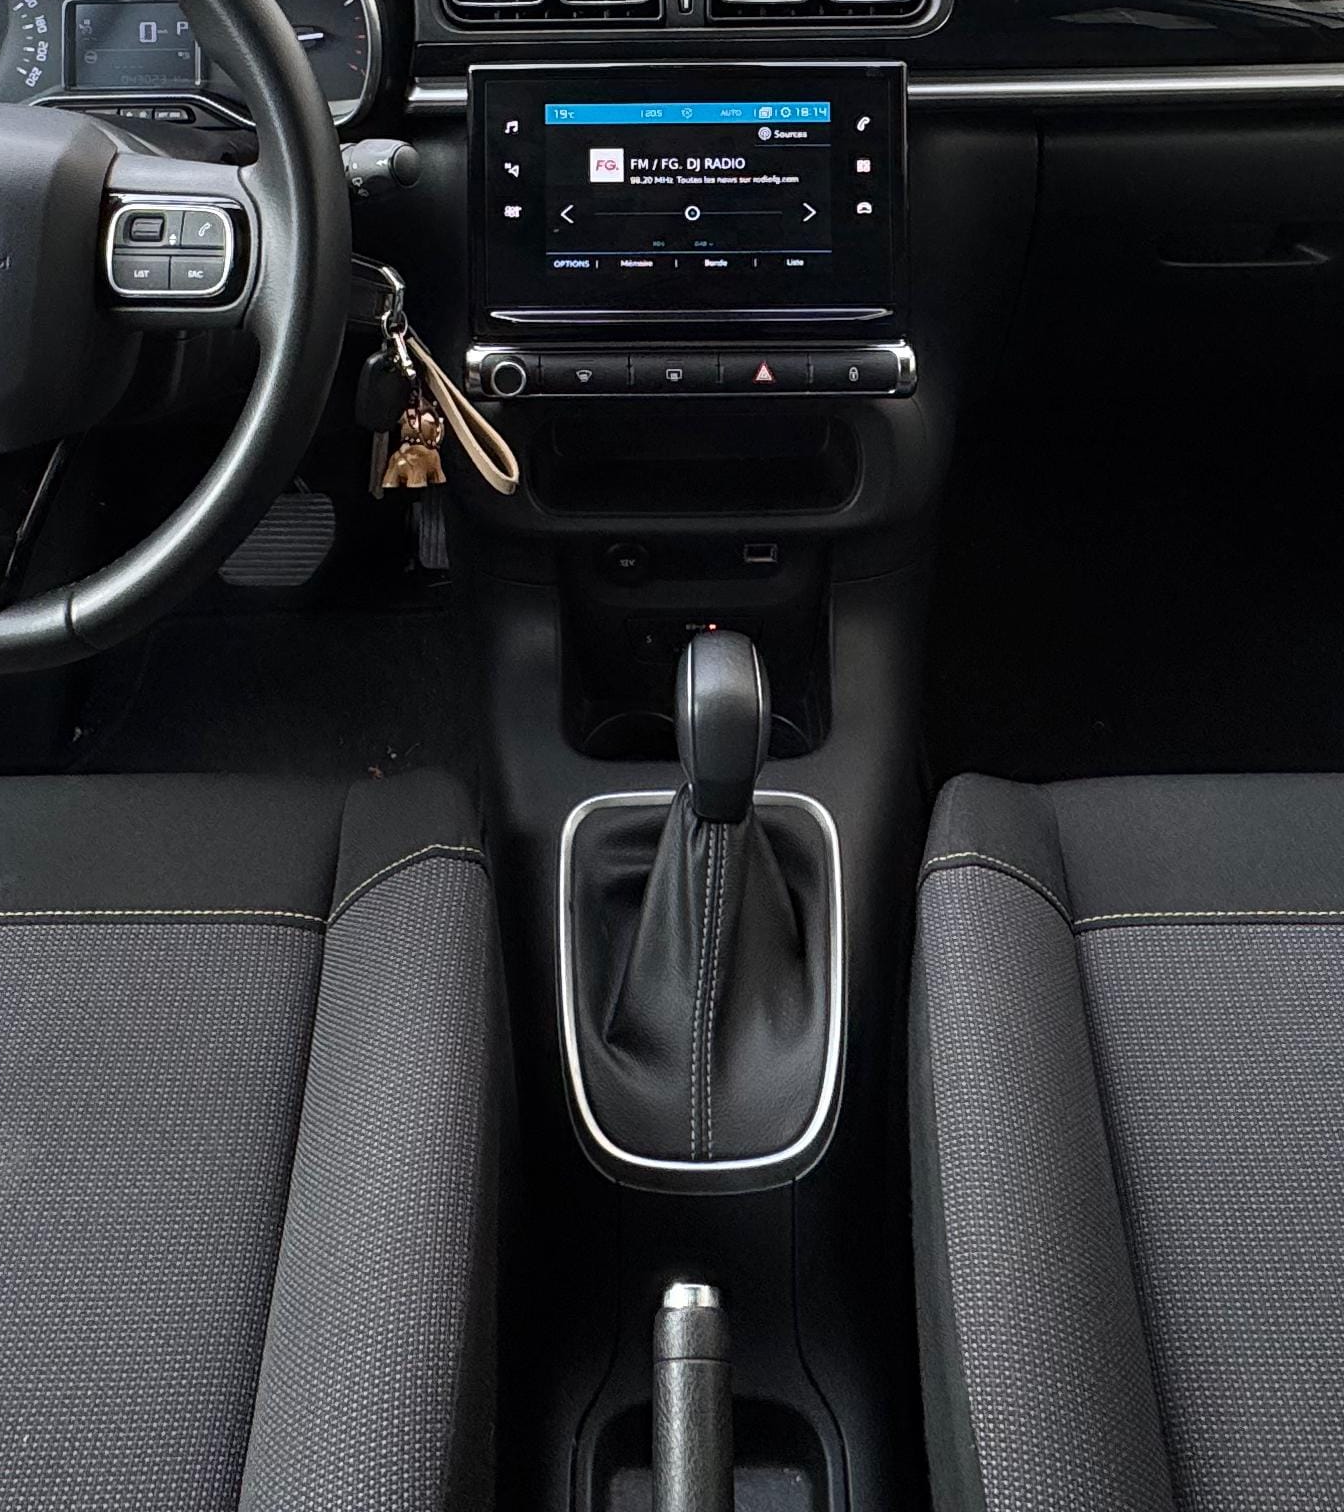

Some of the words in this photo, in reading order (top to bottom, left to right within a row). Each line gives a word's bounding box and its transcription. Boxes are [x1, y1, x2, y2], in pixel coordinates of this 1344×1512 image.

[34, 15, 48, 33] 180
[176, 21, 189, 36] P
[139, 21, 157, 43] 0
[36, 41, 49, 62] 200
[25, 66, 43, 87] 220
[720, 109, 742, 117] AUTO
[796, 107, 827, 117] 18:14
[774, 130, 808, 138] Sources
[630, 158, 649, 170] FM
[652, 158, 658, 171] /
[661, 158, 683, 170] FG.
[687, 158, 701, 172] DJ
[704, 157, 746, 169] RADIO
[717, 176, 738, 184] news
[553, 259, 590, 268] OPTIONS
